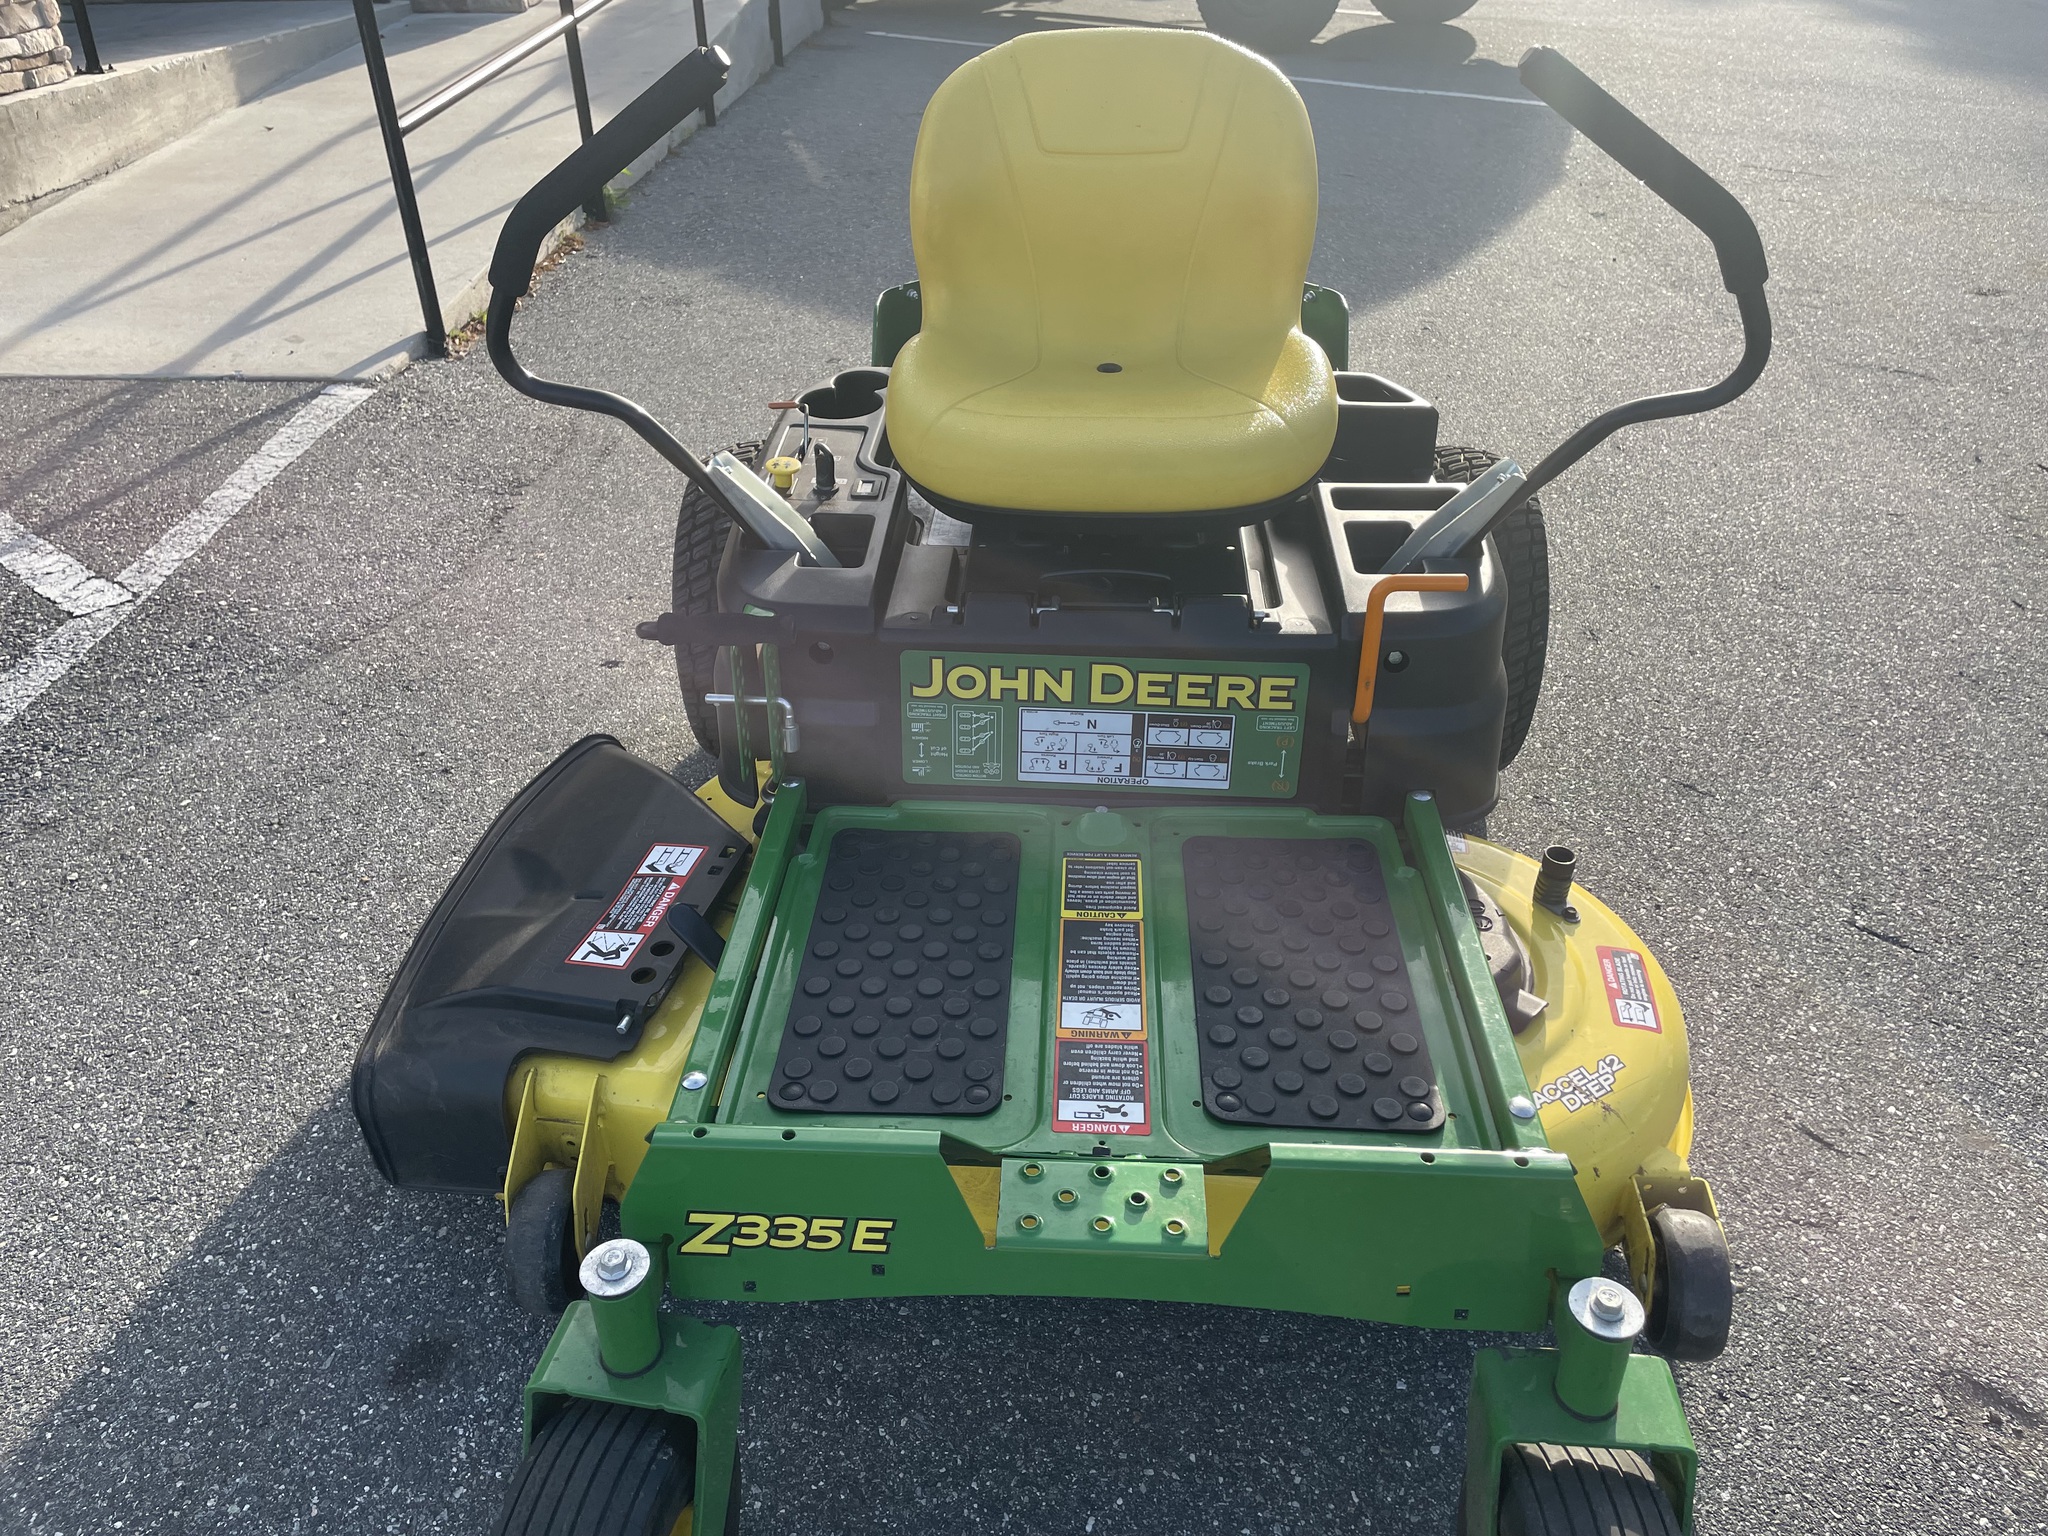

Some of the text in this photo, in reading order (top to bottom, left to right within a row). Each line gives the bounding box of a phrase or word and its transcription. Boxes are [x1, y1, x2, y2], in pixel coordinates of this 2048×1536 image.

[912, 658, 1296, 710] JOHN DEERE
[1087, 719, 1097, 729] N
[1059, 760, 1067, 770] R
[1114, 763, 1122, 773] F
[1097, 777, 1149, 785] OPERATION
[643, 891, 674, 928] DANGER
[1603, 958, 1616, 983] DANGER
[1614, 956, 1628, 995] ROTATING BLADE
[1071, 1030, 1119, 1038] WARNING
[1533, 1054, 1625, 1109] ACCEL 42
[1561, 1074, 1615, 1113] DEEP
[1072, 1123, 1117, 1133] DANGER
[681, 1213, 845, 1254] Z335
